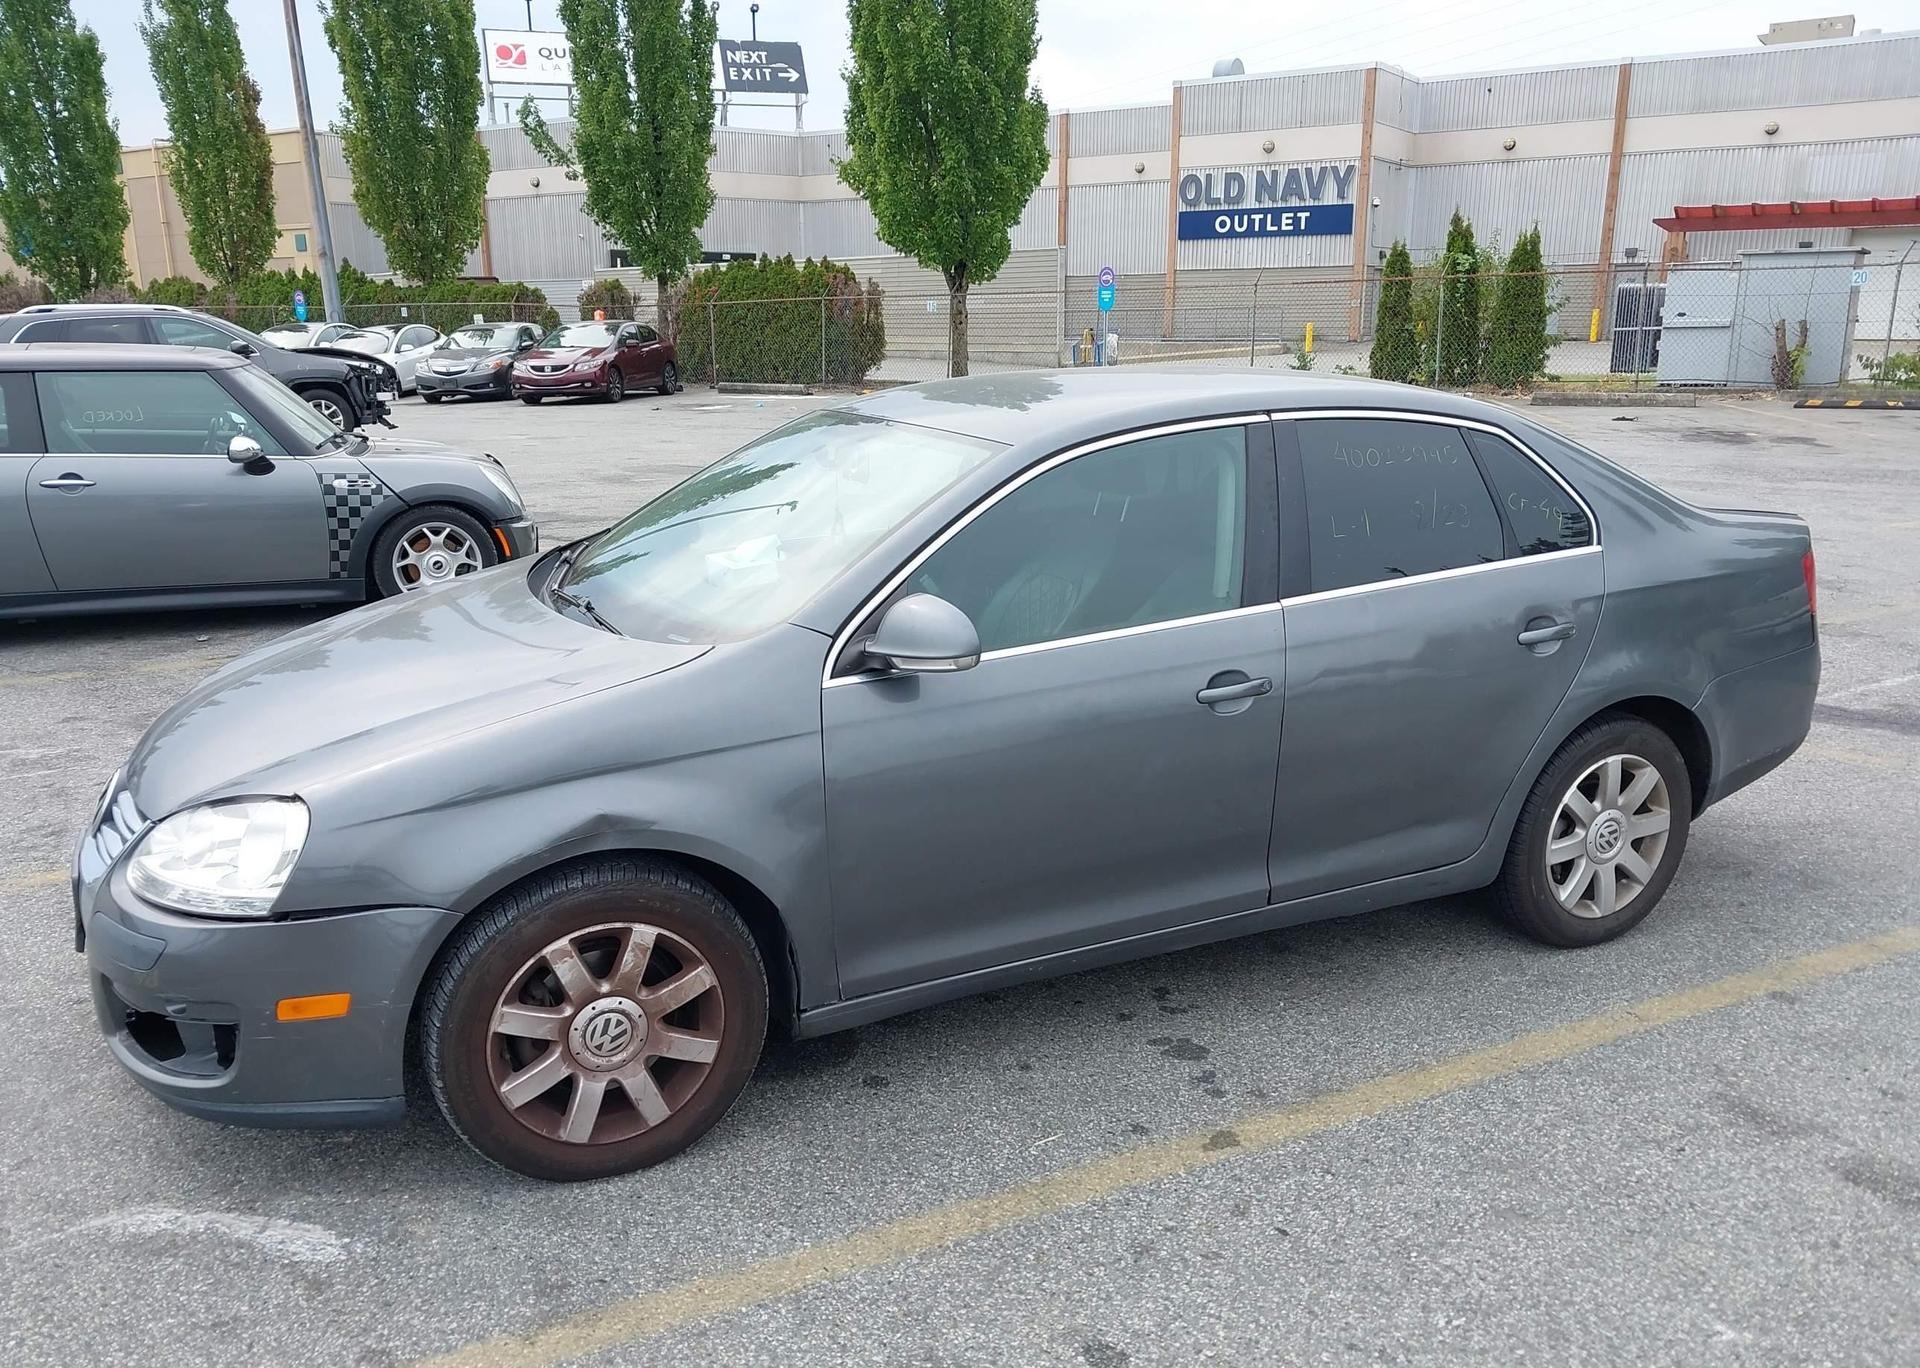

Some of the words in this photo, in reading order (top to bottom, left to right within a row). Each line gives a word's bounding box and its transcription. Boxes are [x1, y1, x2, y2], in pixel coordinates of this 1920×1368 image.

[726, 50, 768, 64] NEXT
[729, 67, 772, 81] EXIT
[1179, 172, 1246, 206] OLD
[1255, 164, 1357, 203] NAVY
[1214, 211, 1311, 234] OUTLET
[1854, 271, 1868, 284] 20
